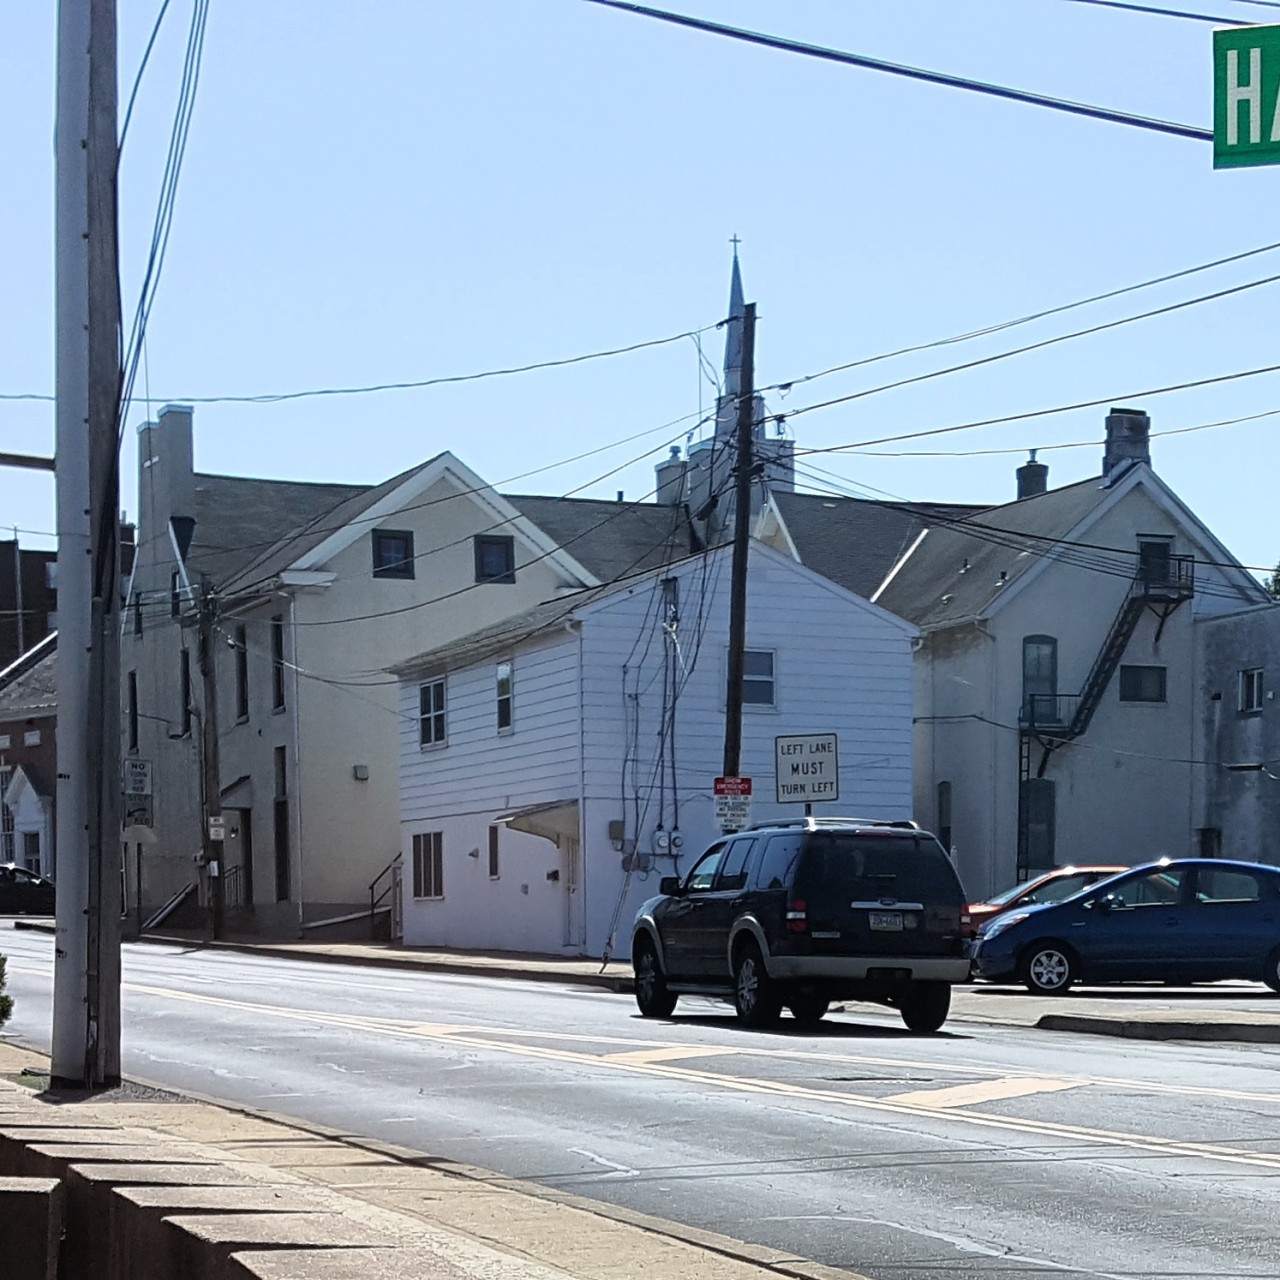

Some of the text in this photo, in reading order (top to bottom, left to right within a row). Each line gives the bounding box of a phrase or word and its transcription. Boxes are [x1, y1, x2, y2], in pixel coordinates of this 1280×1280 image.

[780, 742, 833, 755] LEFT LANE
[791, 761, 824, 776] MUST
[780, 781, 834, 795] TURN LEFT
